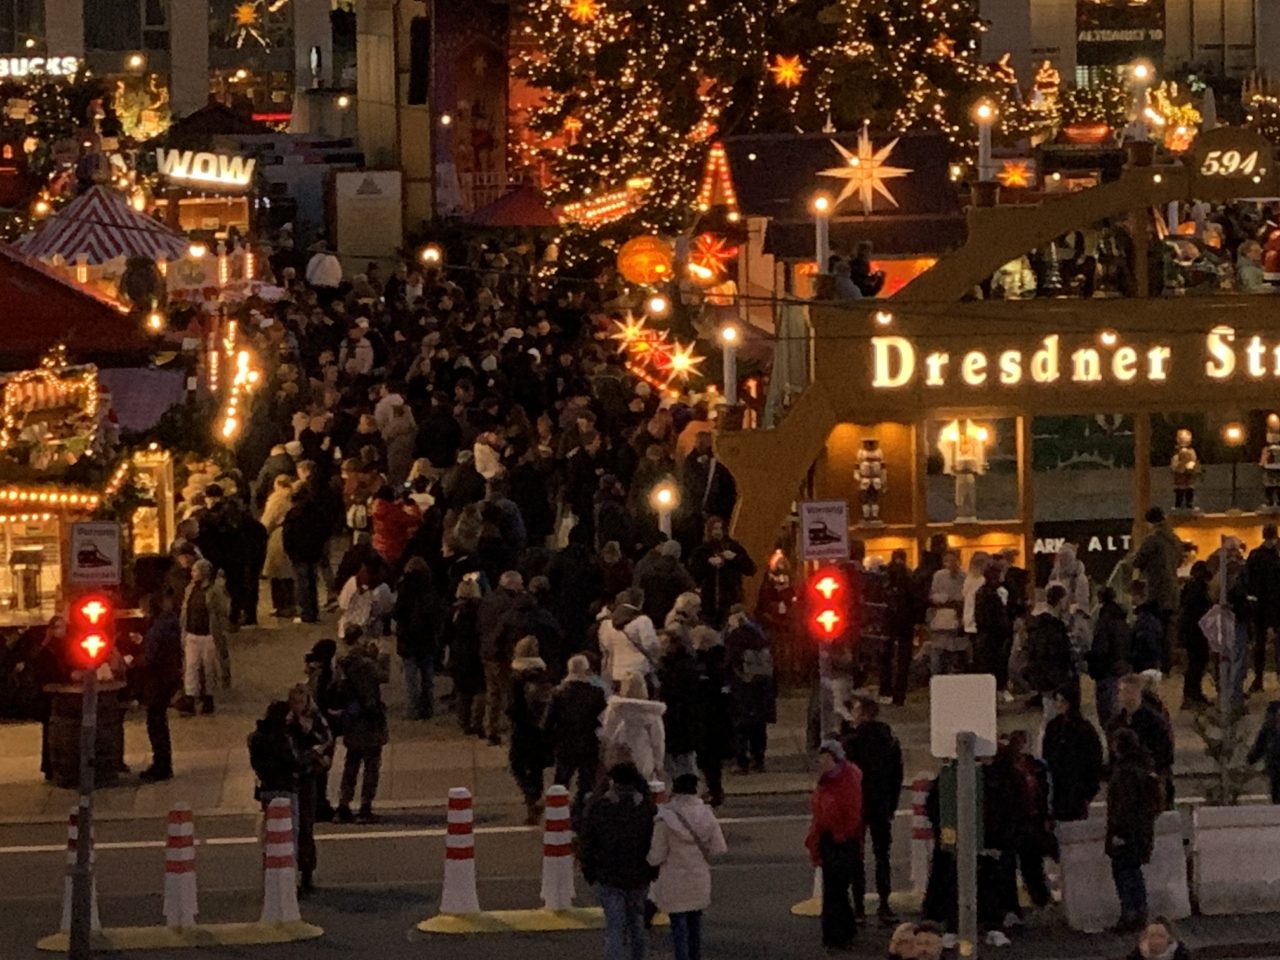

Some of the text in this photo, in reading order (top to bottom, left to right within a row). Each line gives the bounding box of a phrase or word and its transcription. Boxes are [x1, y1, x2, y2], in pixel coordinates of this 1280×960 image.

[156, 147, 256, 185] WOW
[870, 334, 1171, 388] Dresdner
[1087, 535, 1132, 552] ALT
